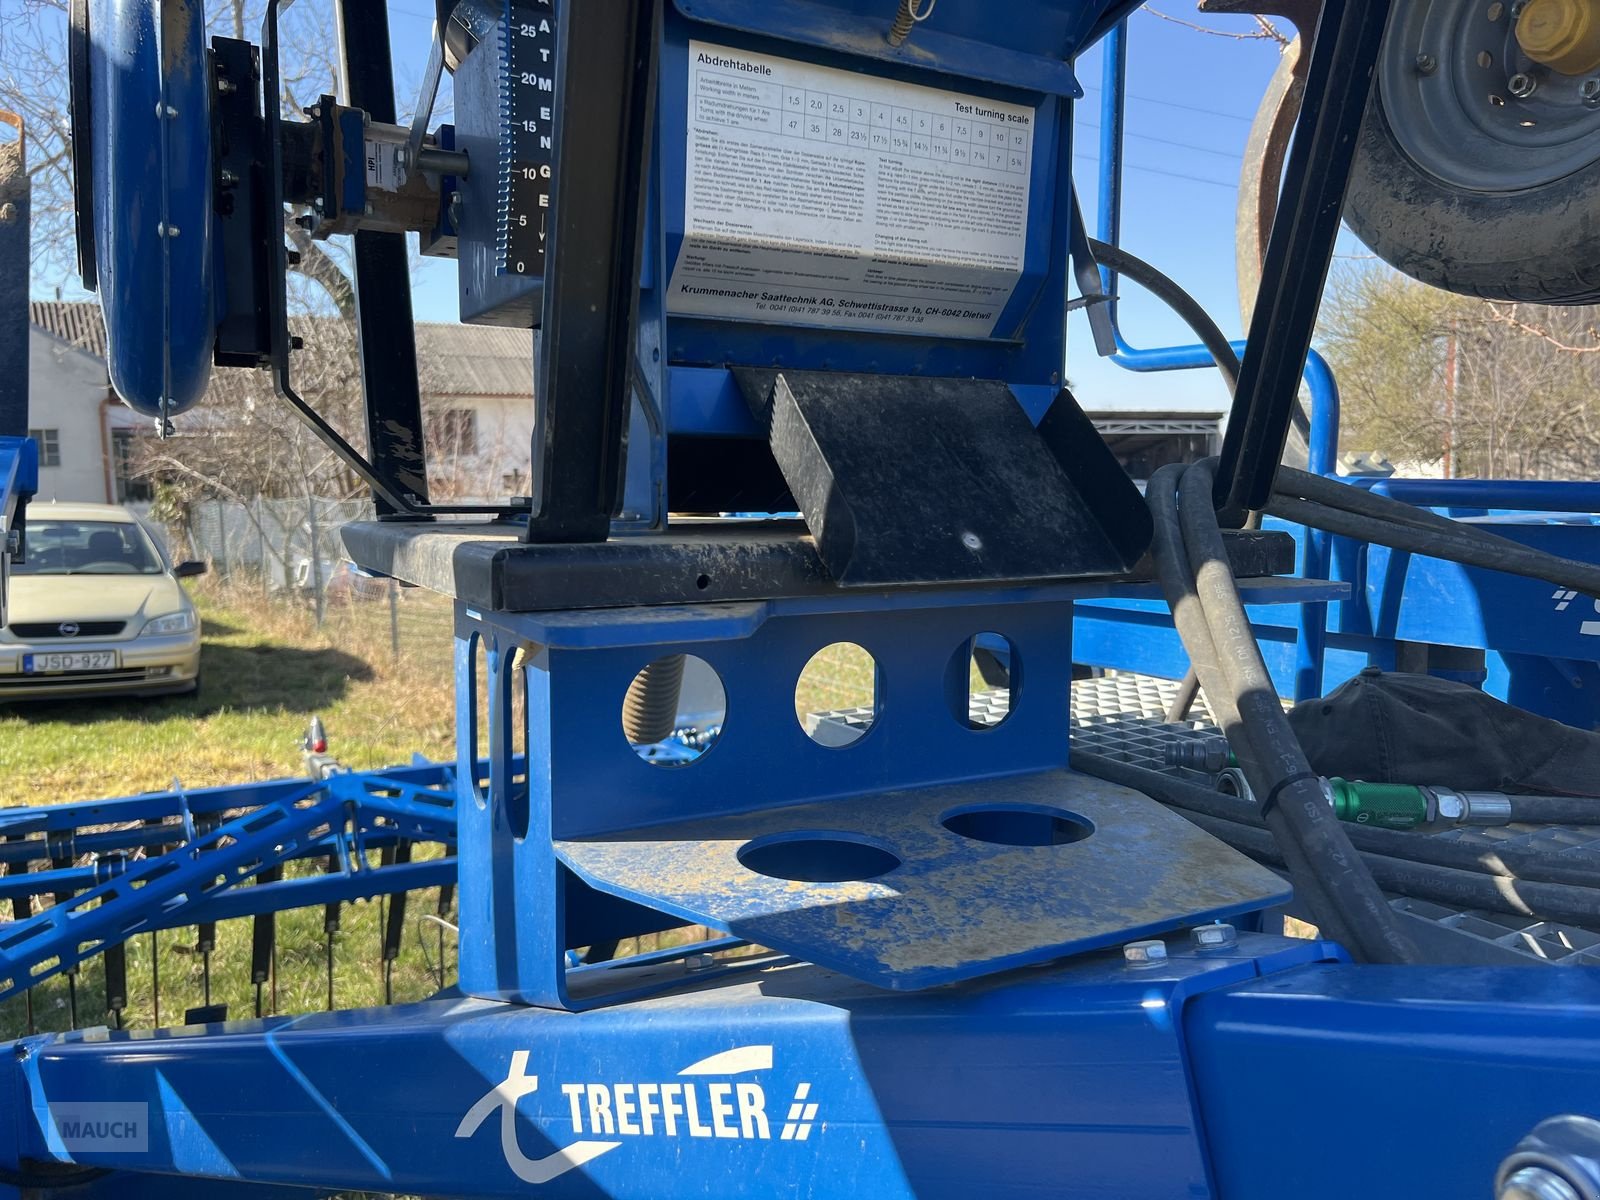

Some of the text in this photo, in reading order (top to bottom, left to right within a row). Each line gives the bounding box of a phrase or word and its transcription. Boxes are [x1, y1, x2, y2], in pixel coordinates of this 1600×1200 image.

[520, 24, 536, 37] 25
[697, 53, 772, 76] Abdrehtabelle
[521, 72, 537, 85] 20
[788, 95, 800, 106] 1,5
[810, 100, 822, 110] 2,0
[832, 103, 844, 114] 2,5
[857, 108, 862, 117] 3
[878, 112, 883, 120] 4
[896, 116, 907, 125] 4,5
[940, 123, 945, 131] 6
[979, 130, 983, 138] 9
[996, 133, 1004, 141] 10
[955, 102, 1030, 125] Test turning scale
[522, 120, 537, 132] 15
[788, 120, 798, 129] 47
[811, 125, 820, 134] 35
[832, 128, 842, 137] 28
[996, 155, 1001, 163] 7
[522, 168, 536, 180] 10
[519, 215, 527, 226] 5
[517, 261, 525, 273] 0
[680, 285, 759, 300] Krummenacher
[760, 292, 817, 305] Saattechnik
[819, 298, 835, 307] AG,
[838, 299, 909, 313] Schwettistrasse
[925, 307, 962, 318] CH-6042
[963, 310, 992, 320] Dietwil
[843, 310, 857, 318] Fax
[38, 654, 112, 670] JSD-927
[561, 1083, 771, 1140] TREFFLER
